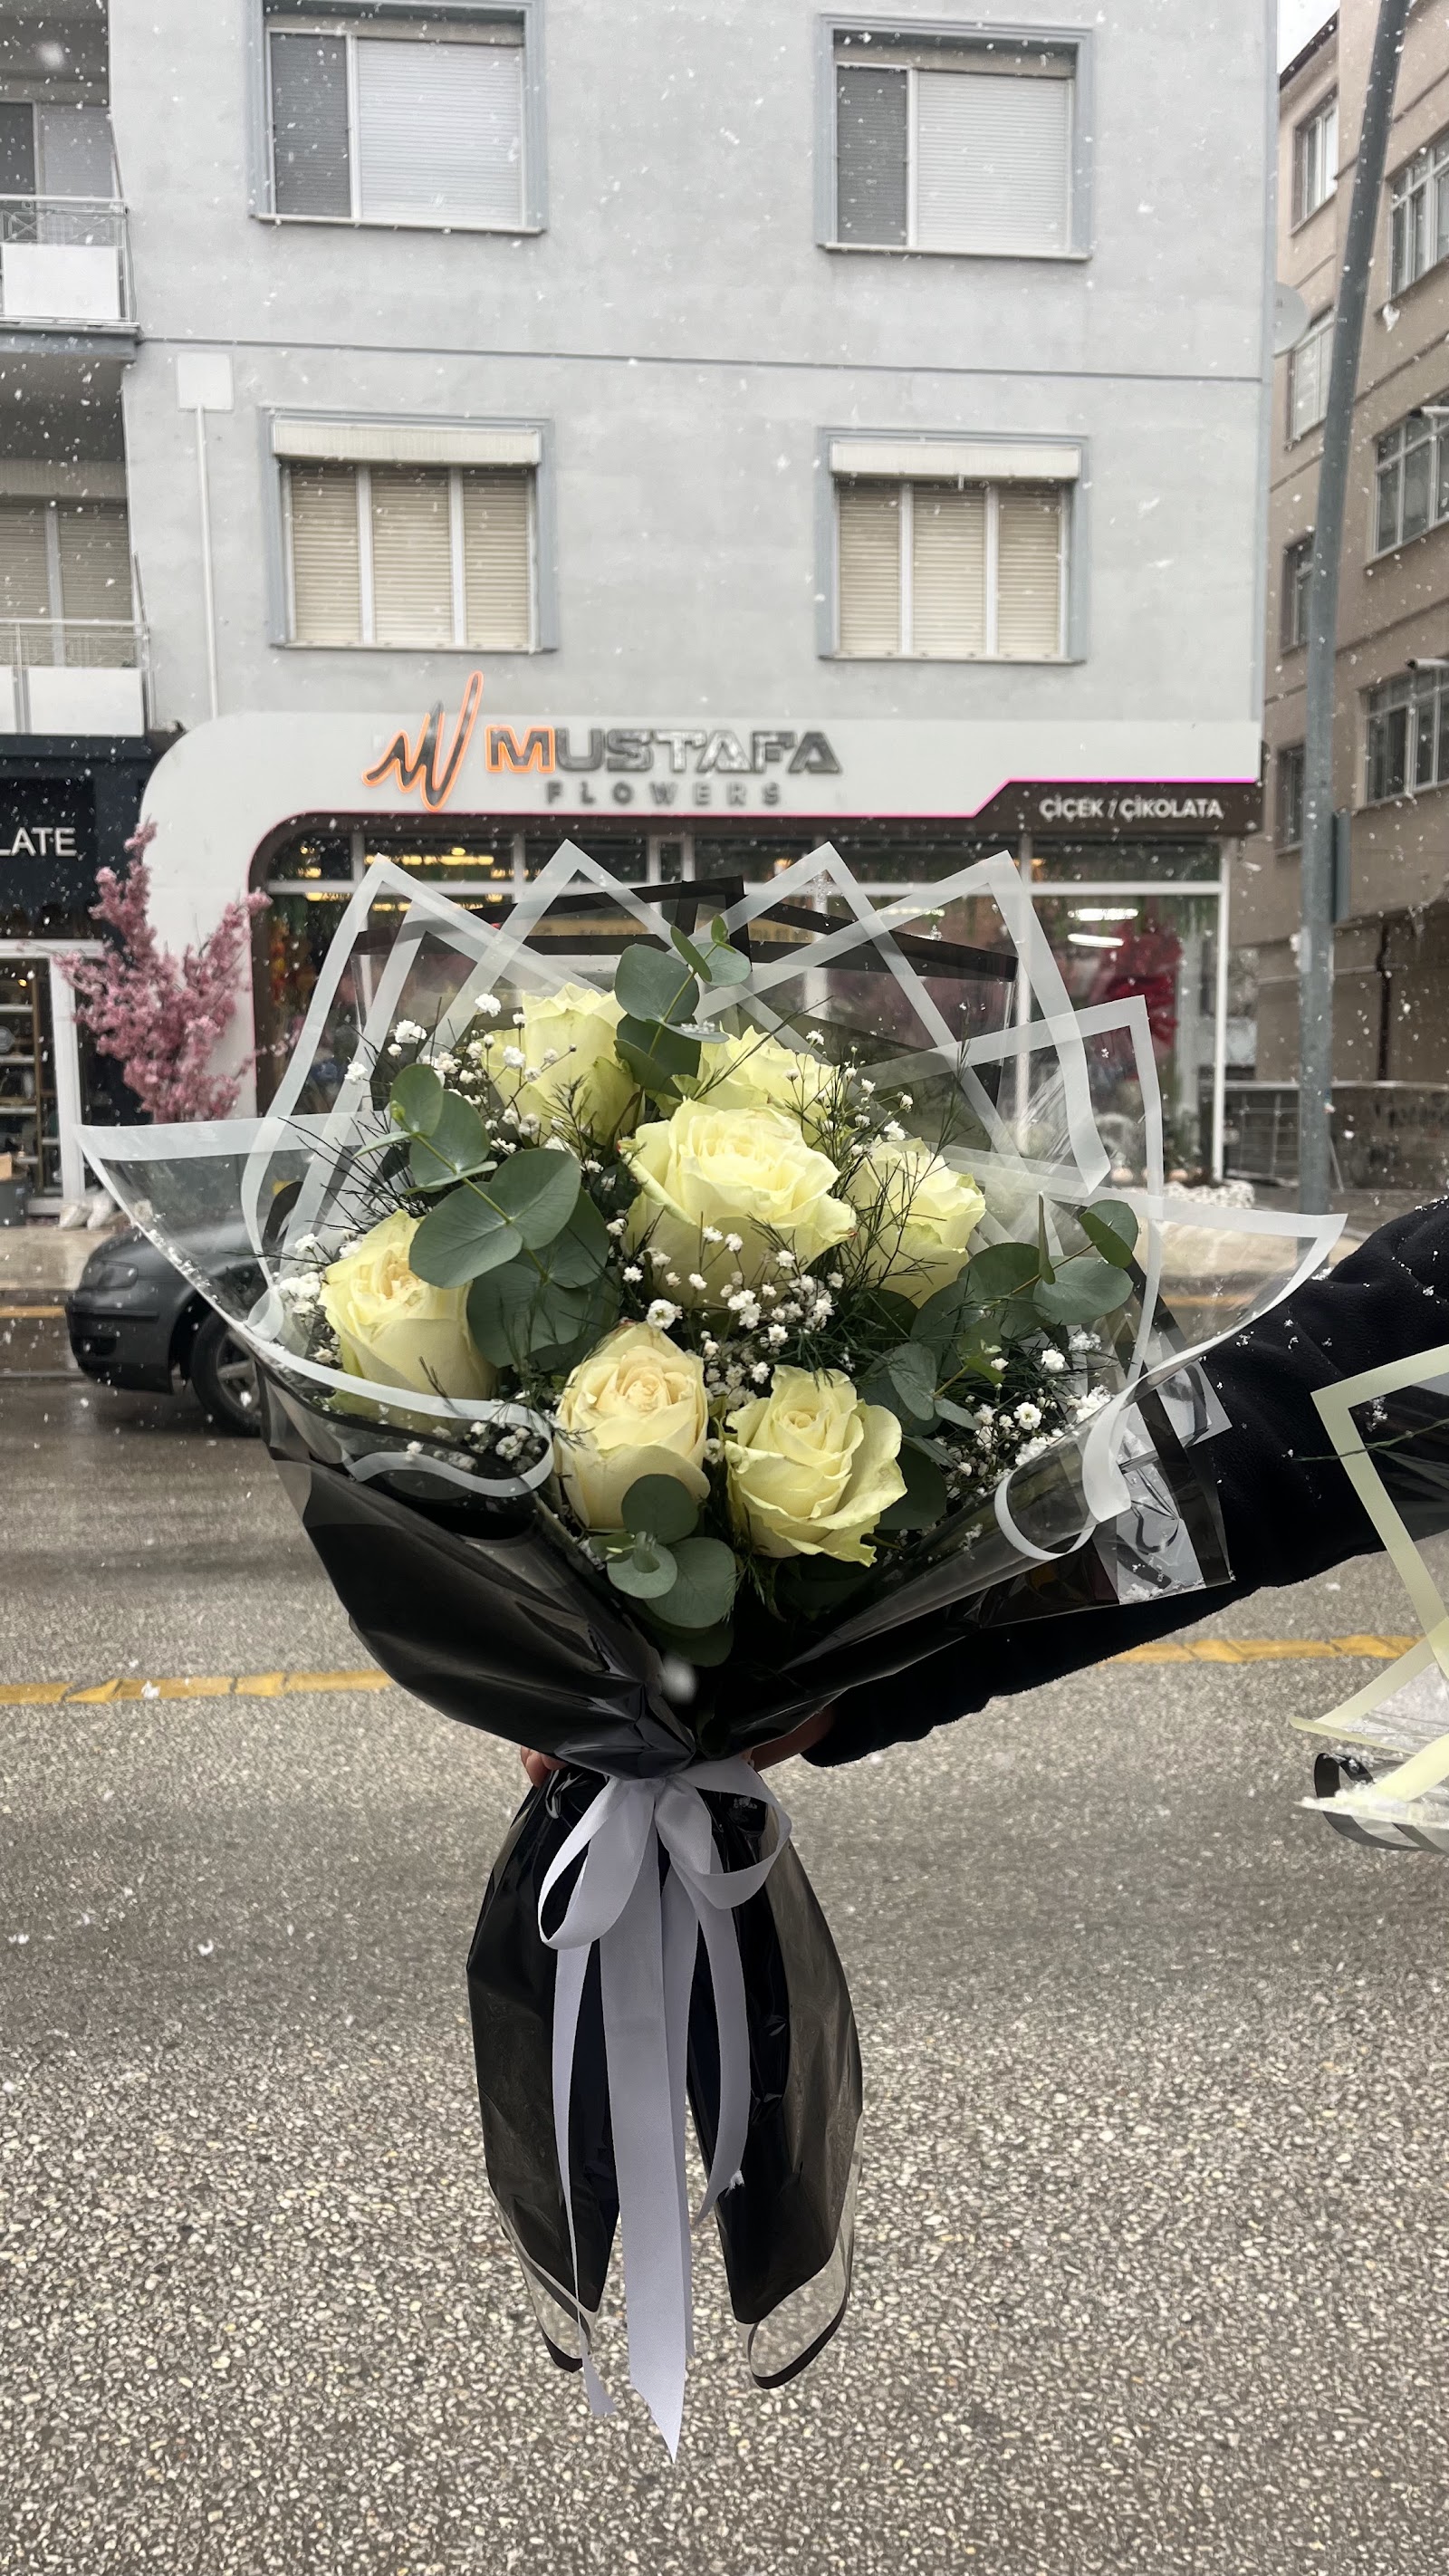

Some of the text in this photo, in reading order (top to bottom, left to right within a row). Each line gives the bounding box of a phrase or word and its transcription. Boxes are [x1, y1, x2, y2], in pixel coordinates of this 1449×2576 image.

[485, 724, 843, 775] MUSTAFA
[545, 780, 783, 806] FLOWERS
[1039, 793, 1104, 822] ÇİÇEK
[1118, 793, 1224, 822] ÇİKOLATA
